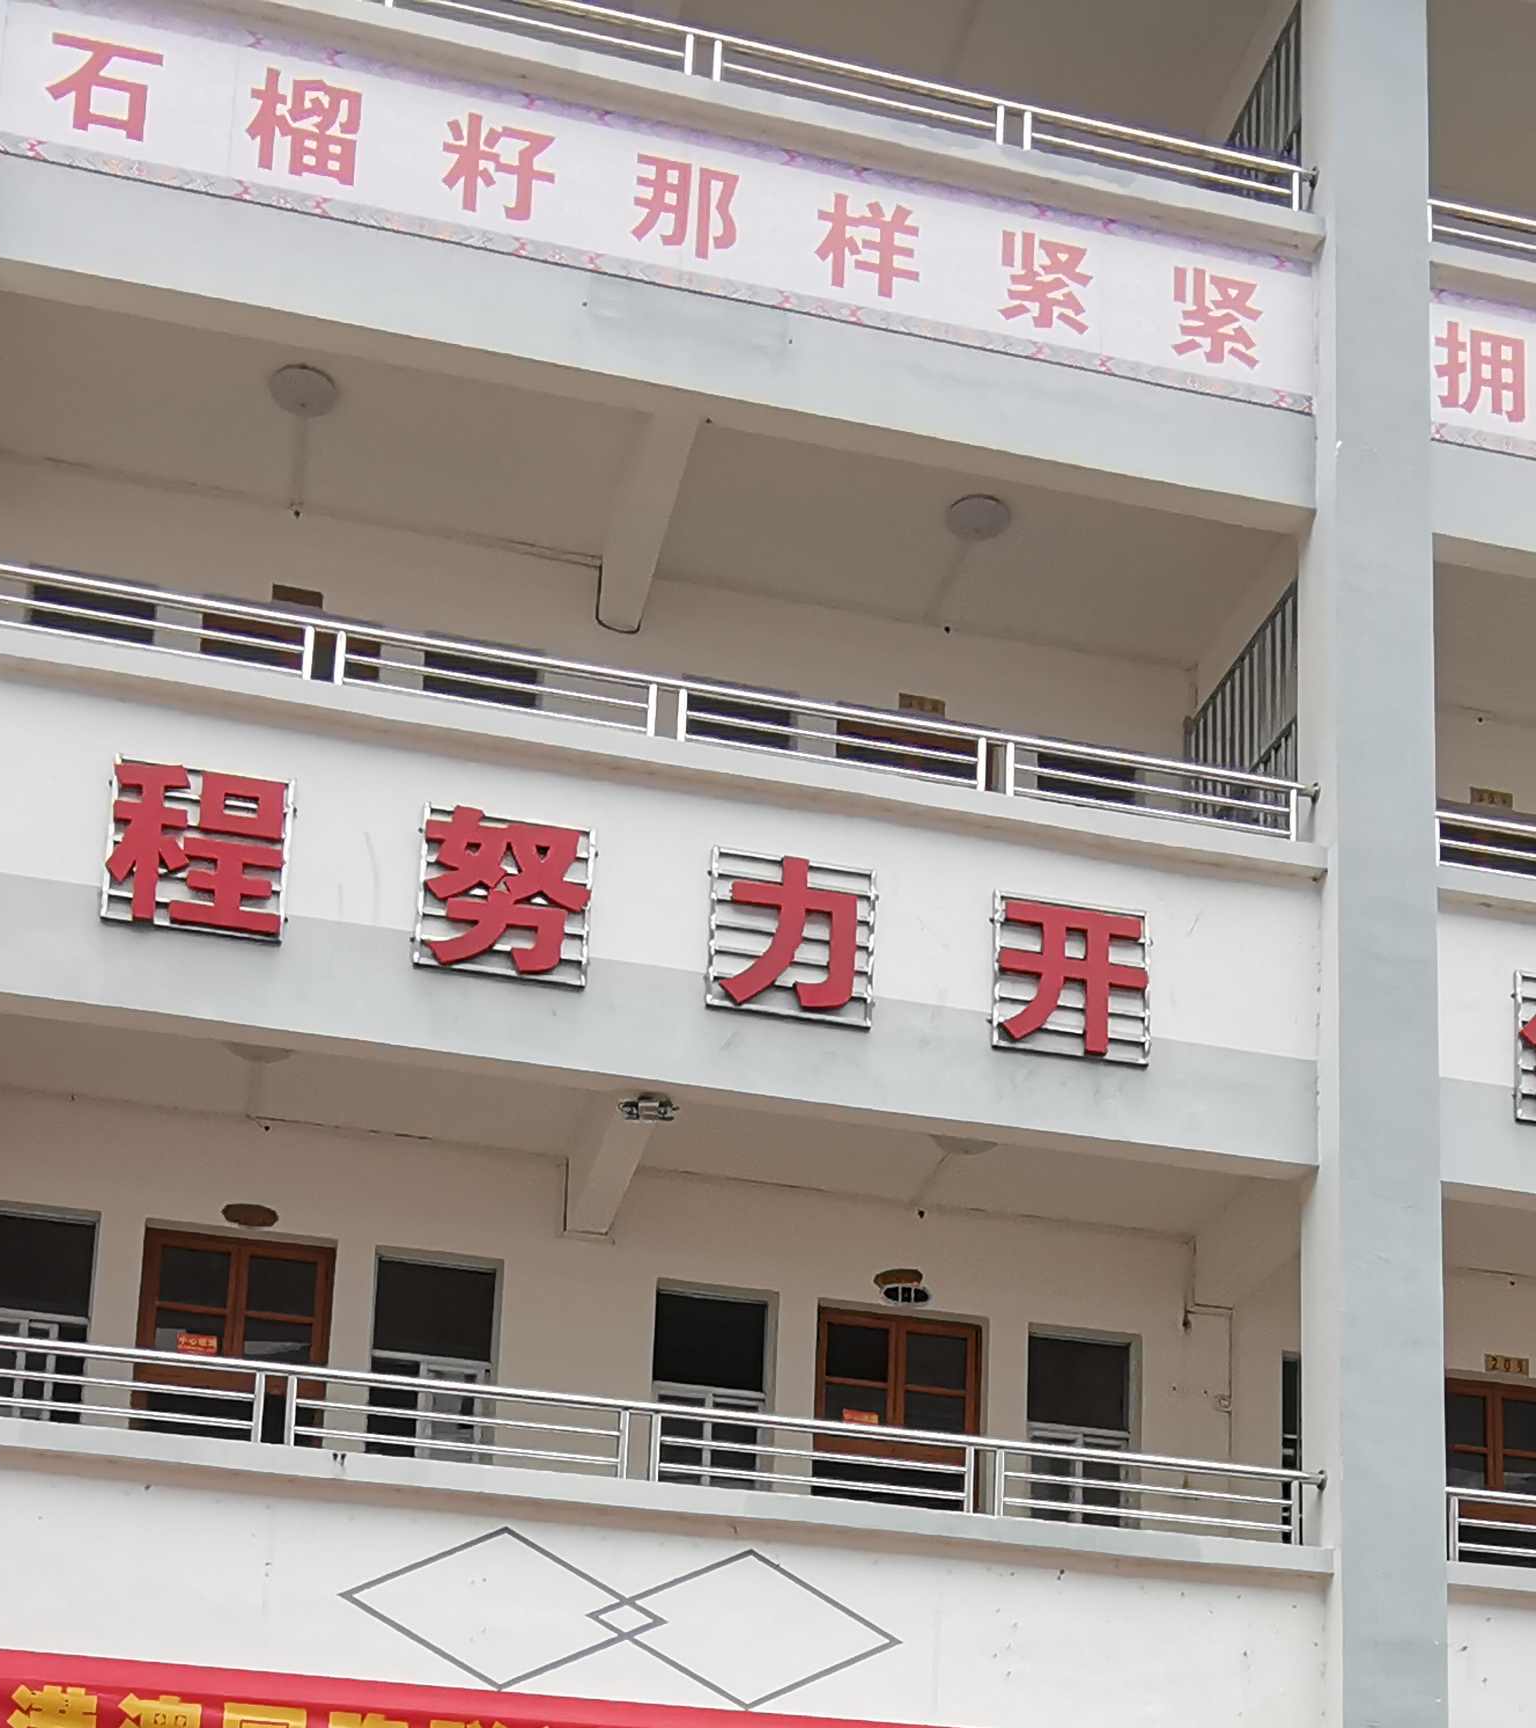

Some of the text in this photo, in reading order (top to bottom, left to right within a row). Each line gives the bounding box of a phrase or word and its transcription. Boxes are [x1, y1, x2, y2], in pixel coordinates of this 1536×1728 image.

[47, 33, 1259, 368] 石榴籽那样紧紧
[108, 763, 1148, 1055] 程努力开
